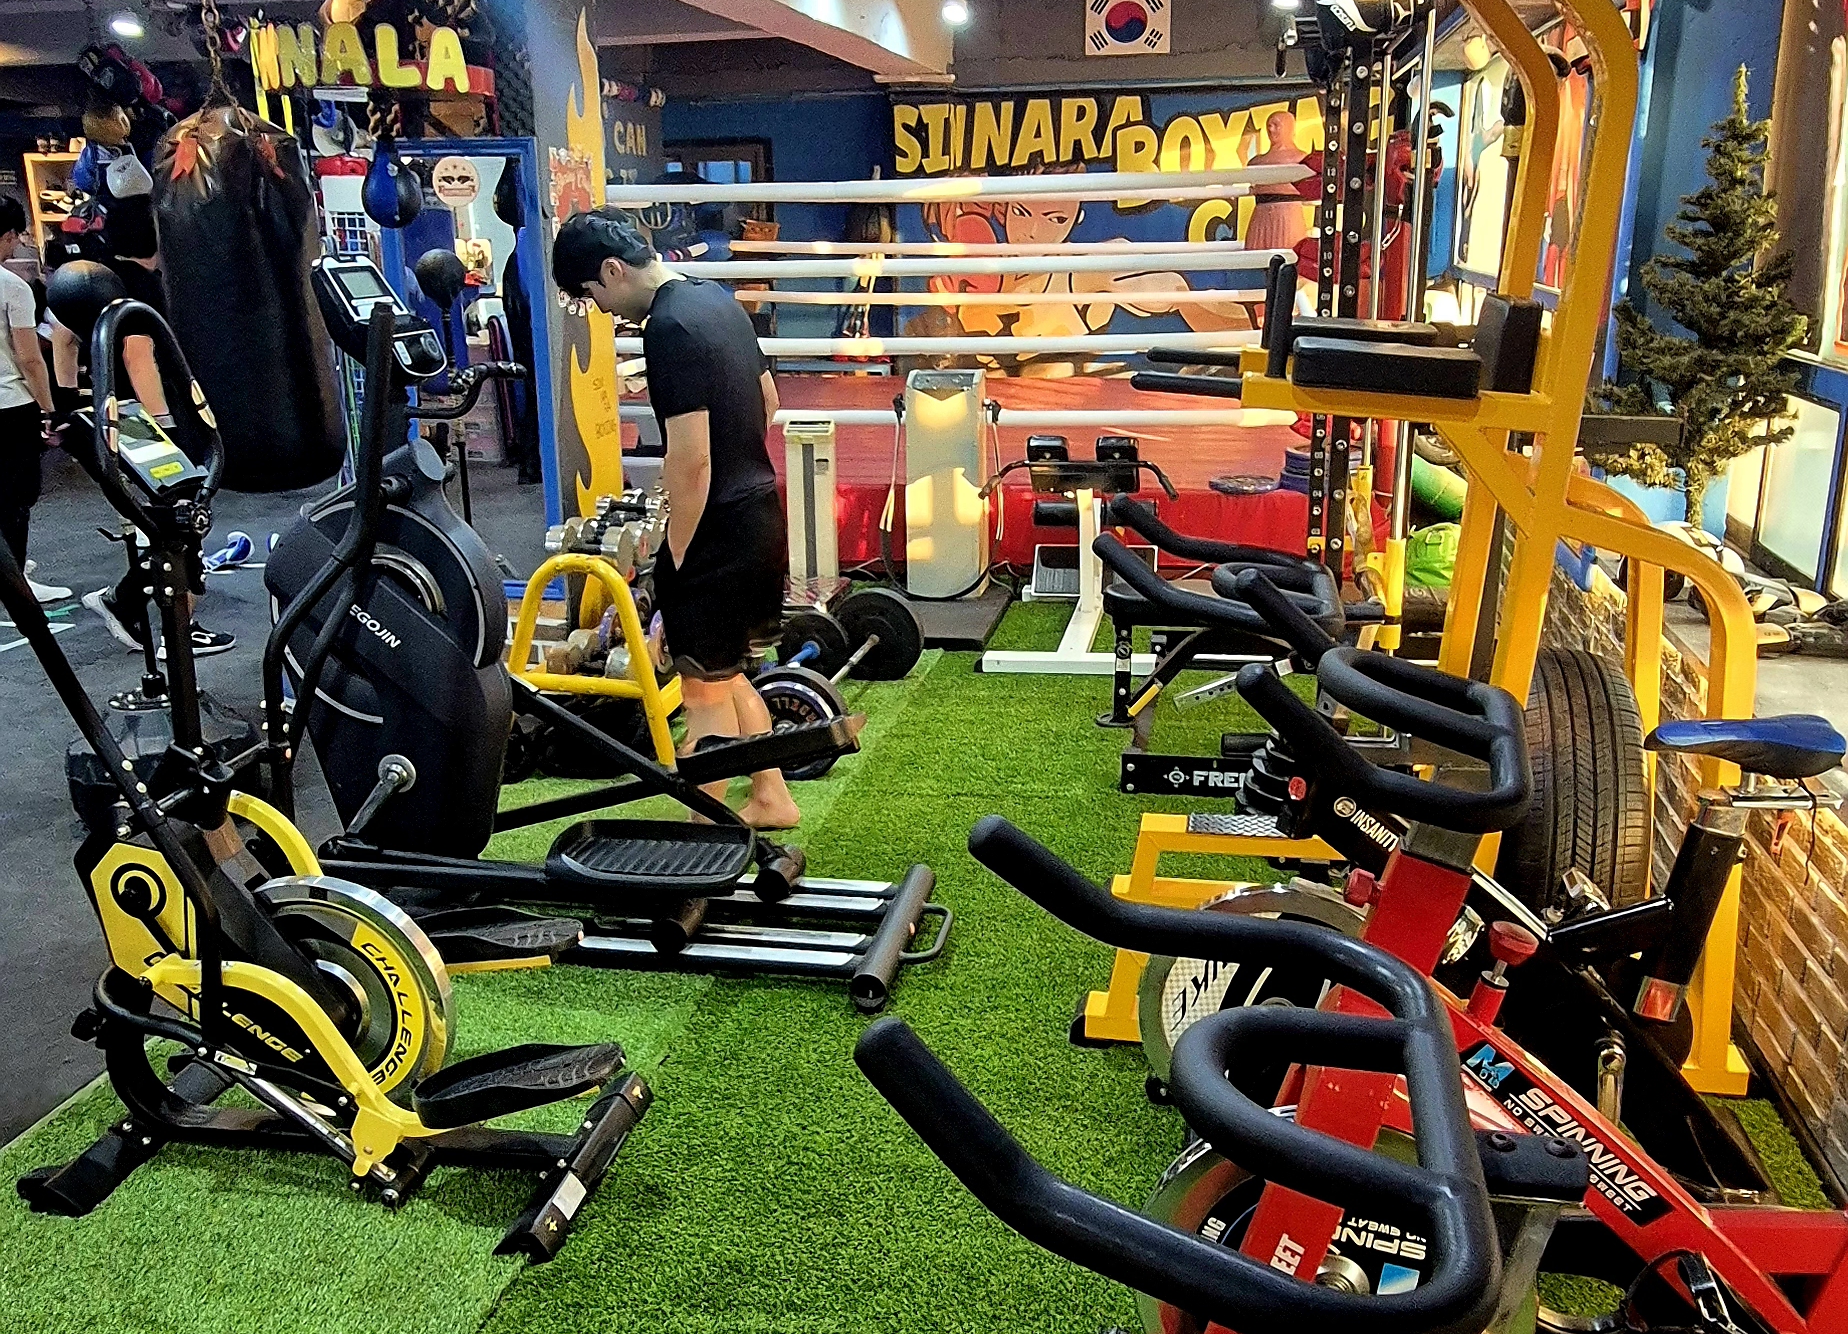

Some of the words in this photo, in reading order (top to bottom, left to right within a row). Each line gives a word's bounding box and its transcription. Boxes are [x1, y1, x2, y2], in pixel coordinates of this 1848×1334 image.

[1193, 770, 1246, 788] FRE
[361, 942, 413, 1086] CHALLENGE
[1503, 1099, 1523, 1116] NO
[1519, 1088, 1657, 1202] SPINNING
[1269, 1233, 1306, 1276] EET
